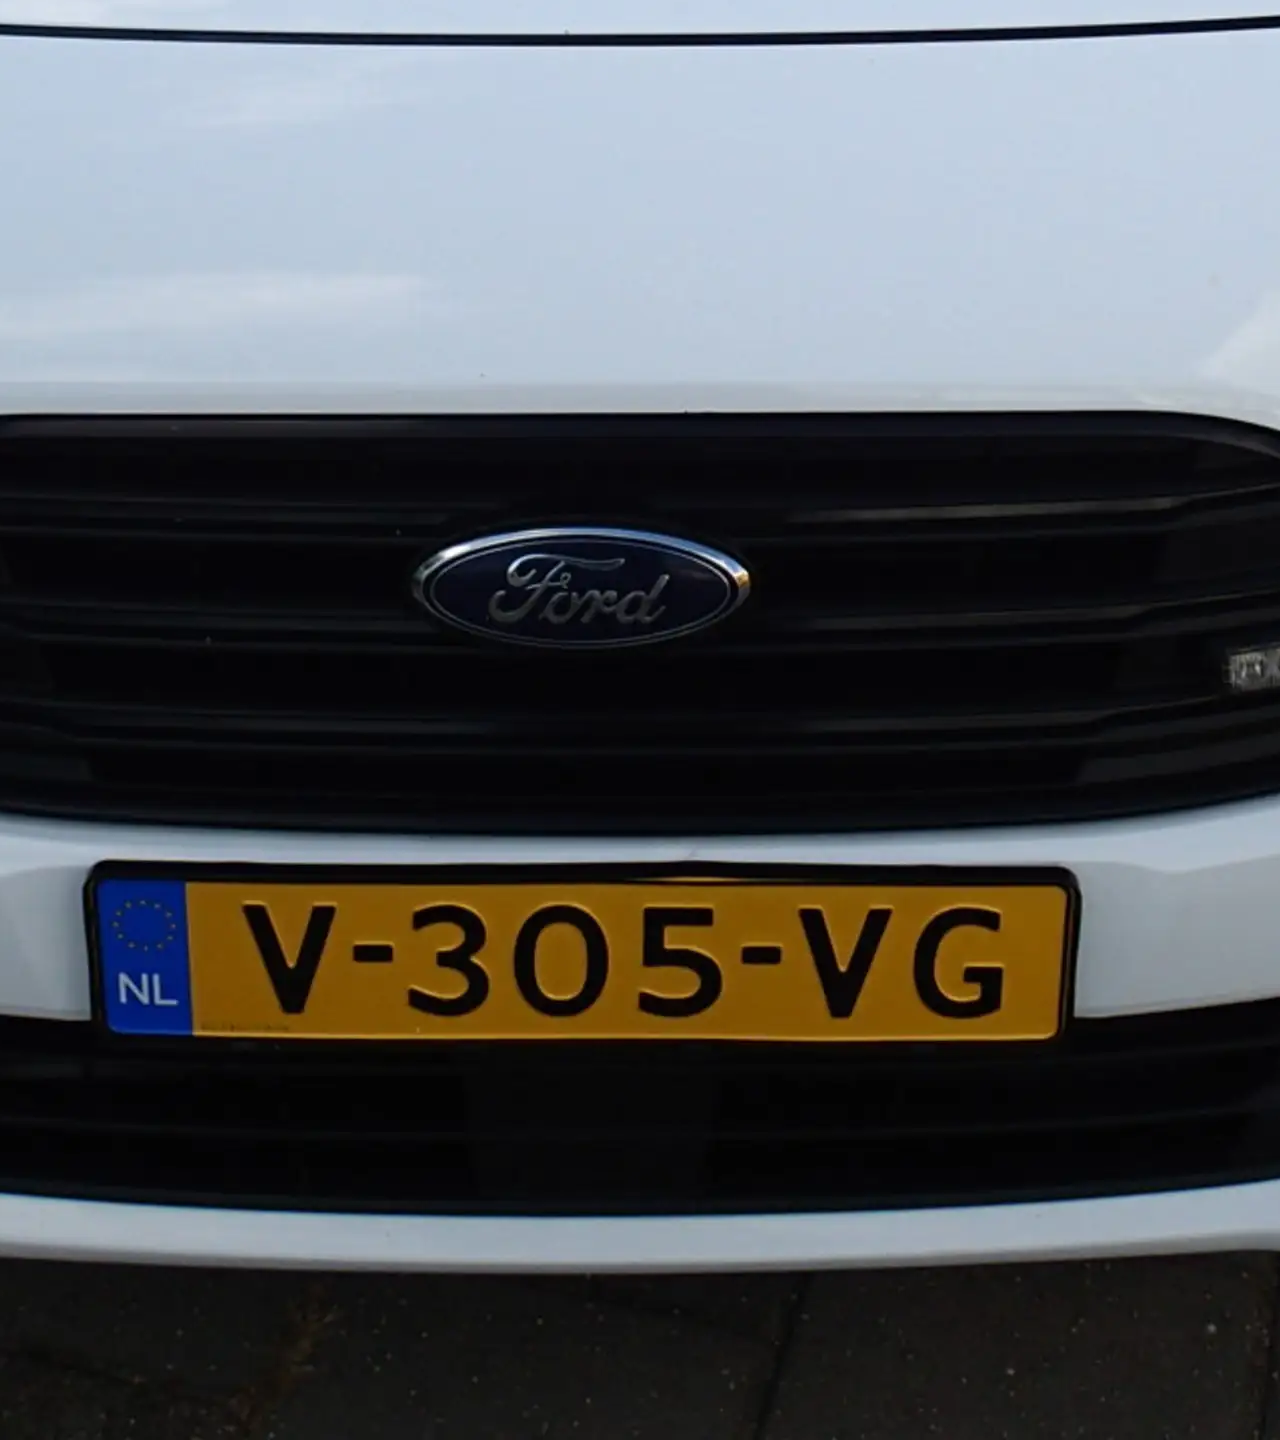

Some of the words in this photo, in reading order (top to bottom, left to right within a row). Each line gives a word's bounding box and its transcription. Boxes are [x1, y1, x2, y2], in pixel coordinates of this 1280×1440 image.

[488, 554, 669, 624] Ford
[118, 971, 179, 1006] NL
[242, 903, 1005, 1019] V-305-VG
